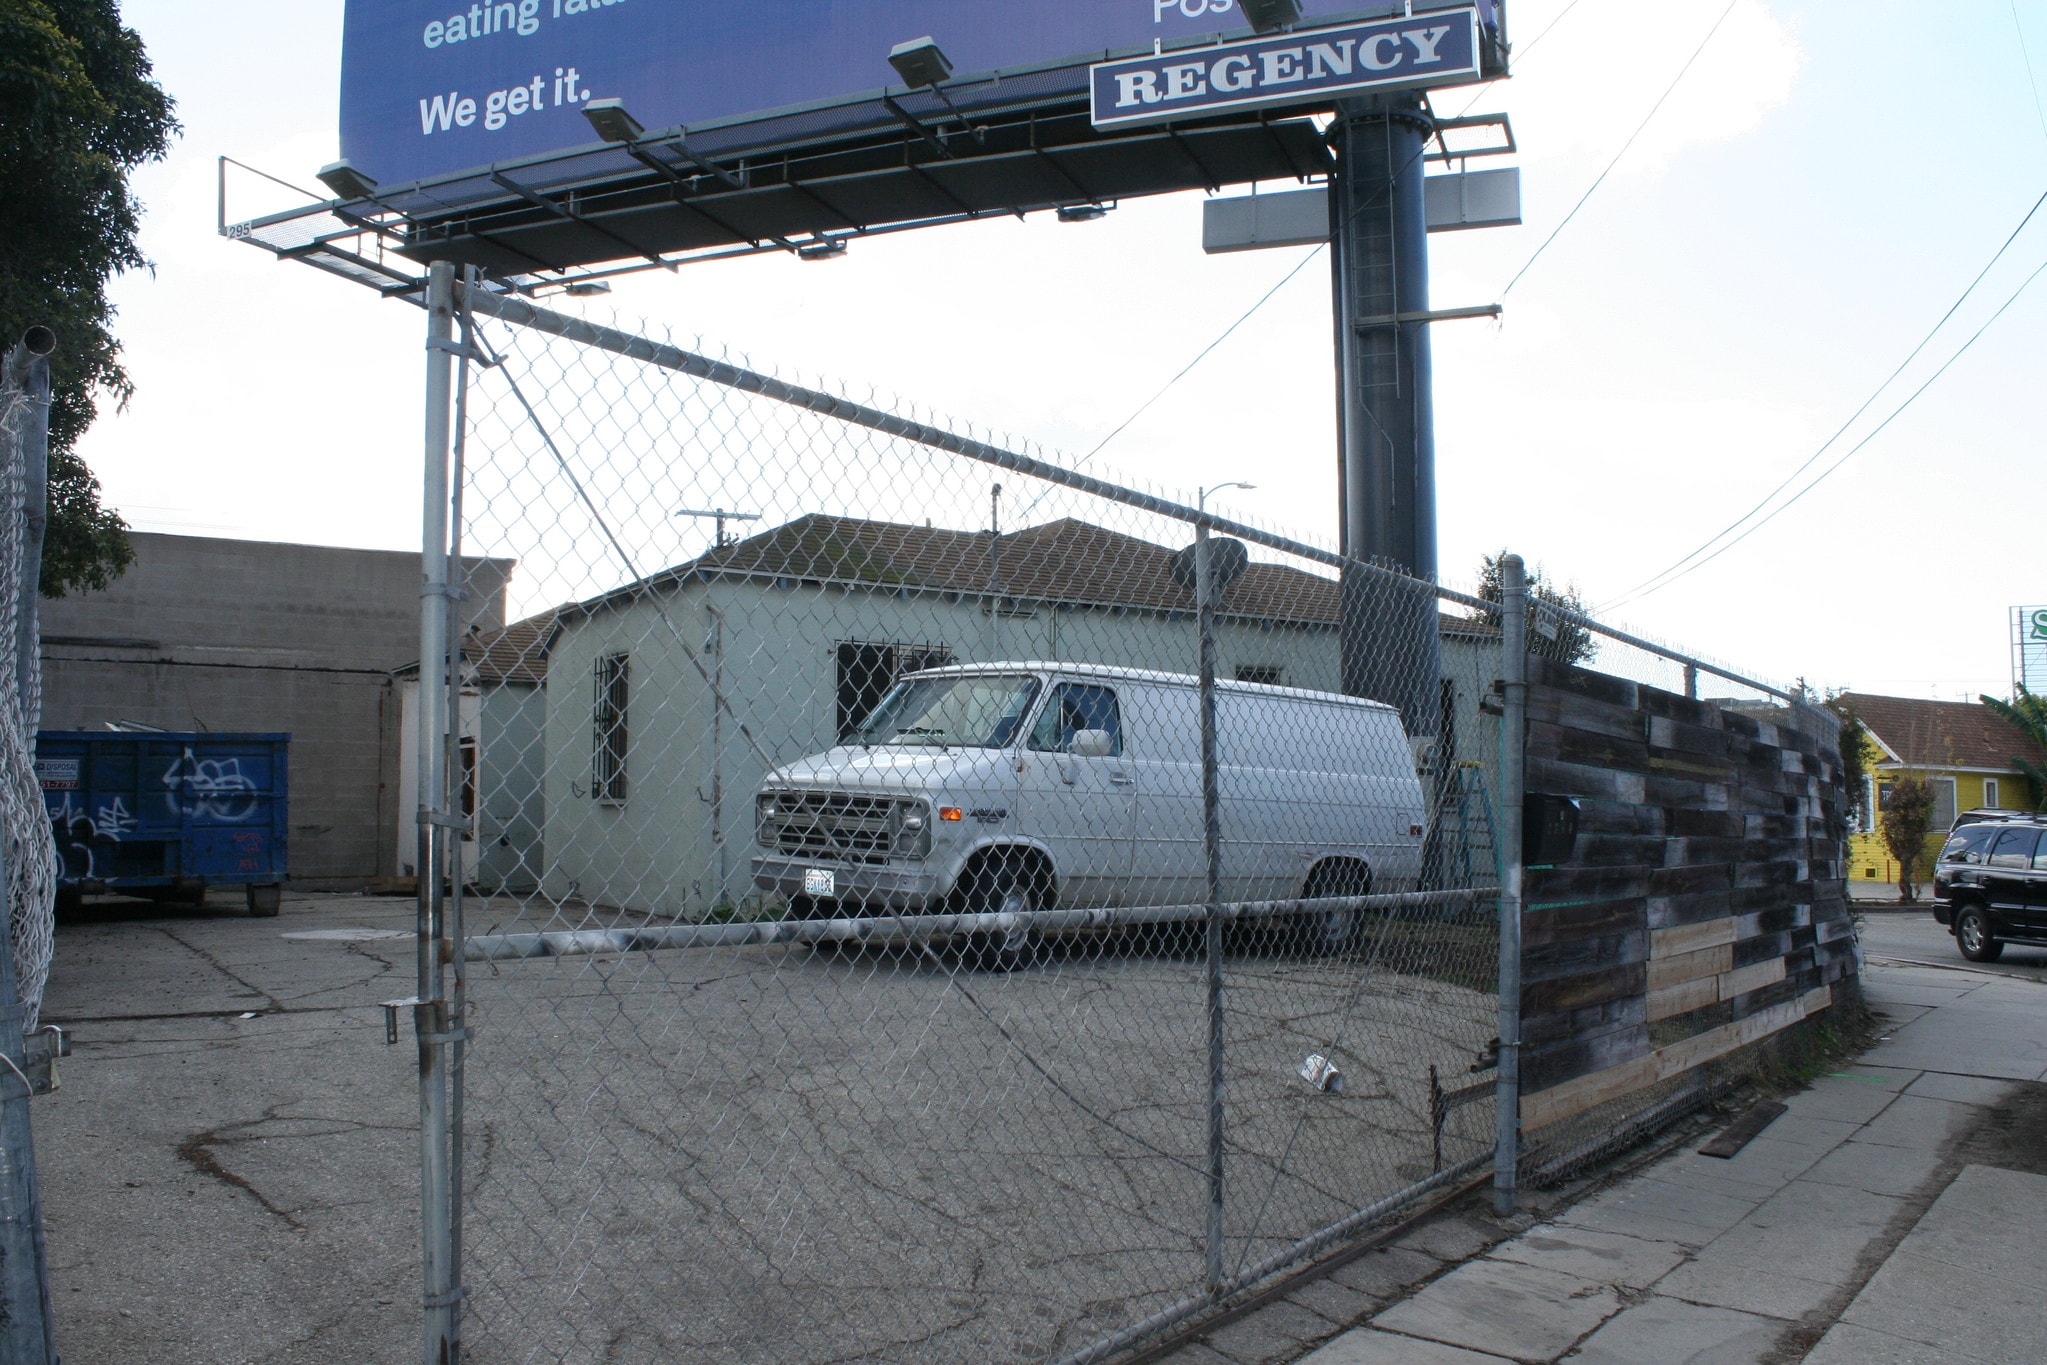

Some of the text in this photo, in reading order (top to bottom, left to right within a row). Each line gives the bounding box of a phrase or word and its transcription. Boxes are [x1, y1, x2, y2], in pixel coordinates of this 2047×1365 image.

[423, 0, 540, 49] eating
[1114, 25, 1451, 108] REGENCY
[420, 67, 591, 136] We get it.
[229, 223, 250, 239] 295
[46, 762, 77, 771] DISPOSAL
